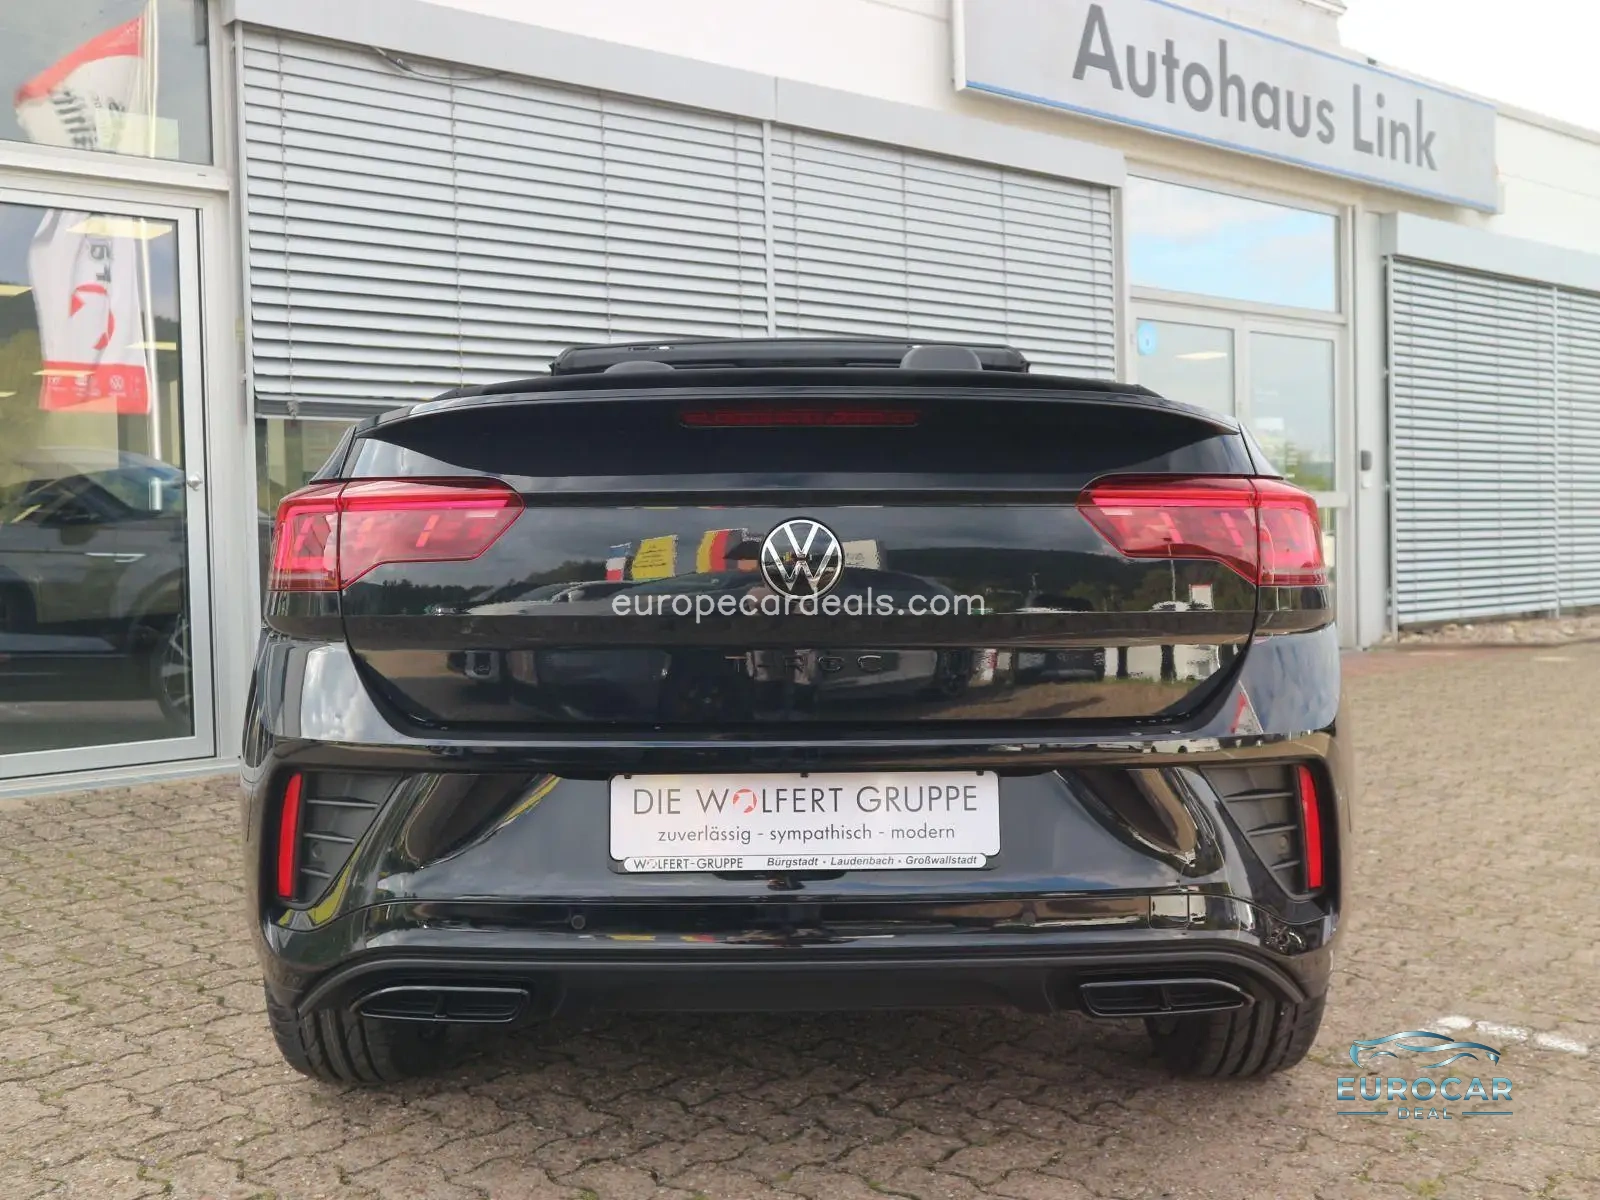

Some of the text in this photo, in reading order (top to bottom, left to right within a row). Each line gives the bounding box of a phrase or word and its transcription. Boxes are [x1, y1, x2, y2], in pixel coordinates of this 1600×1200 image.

[1072, 3, 1438, 171] Autohaus Link
[633, 785, 978, 815] DIE WOLFERT GRUPPE
[658, 825, 751, 844] zuverlässig
[769, 823, 872, 844] sympathisch
[890, 823, 956, 840] modern
[634, 854, 977, 869] WOLFERT-GRUPPE Bürgstadt Laudenbach Großwallstadt
